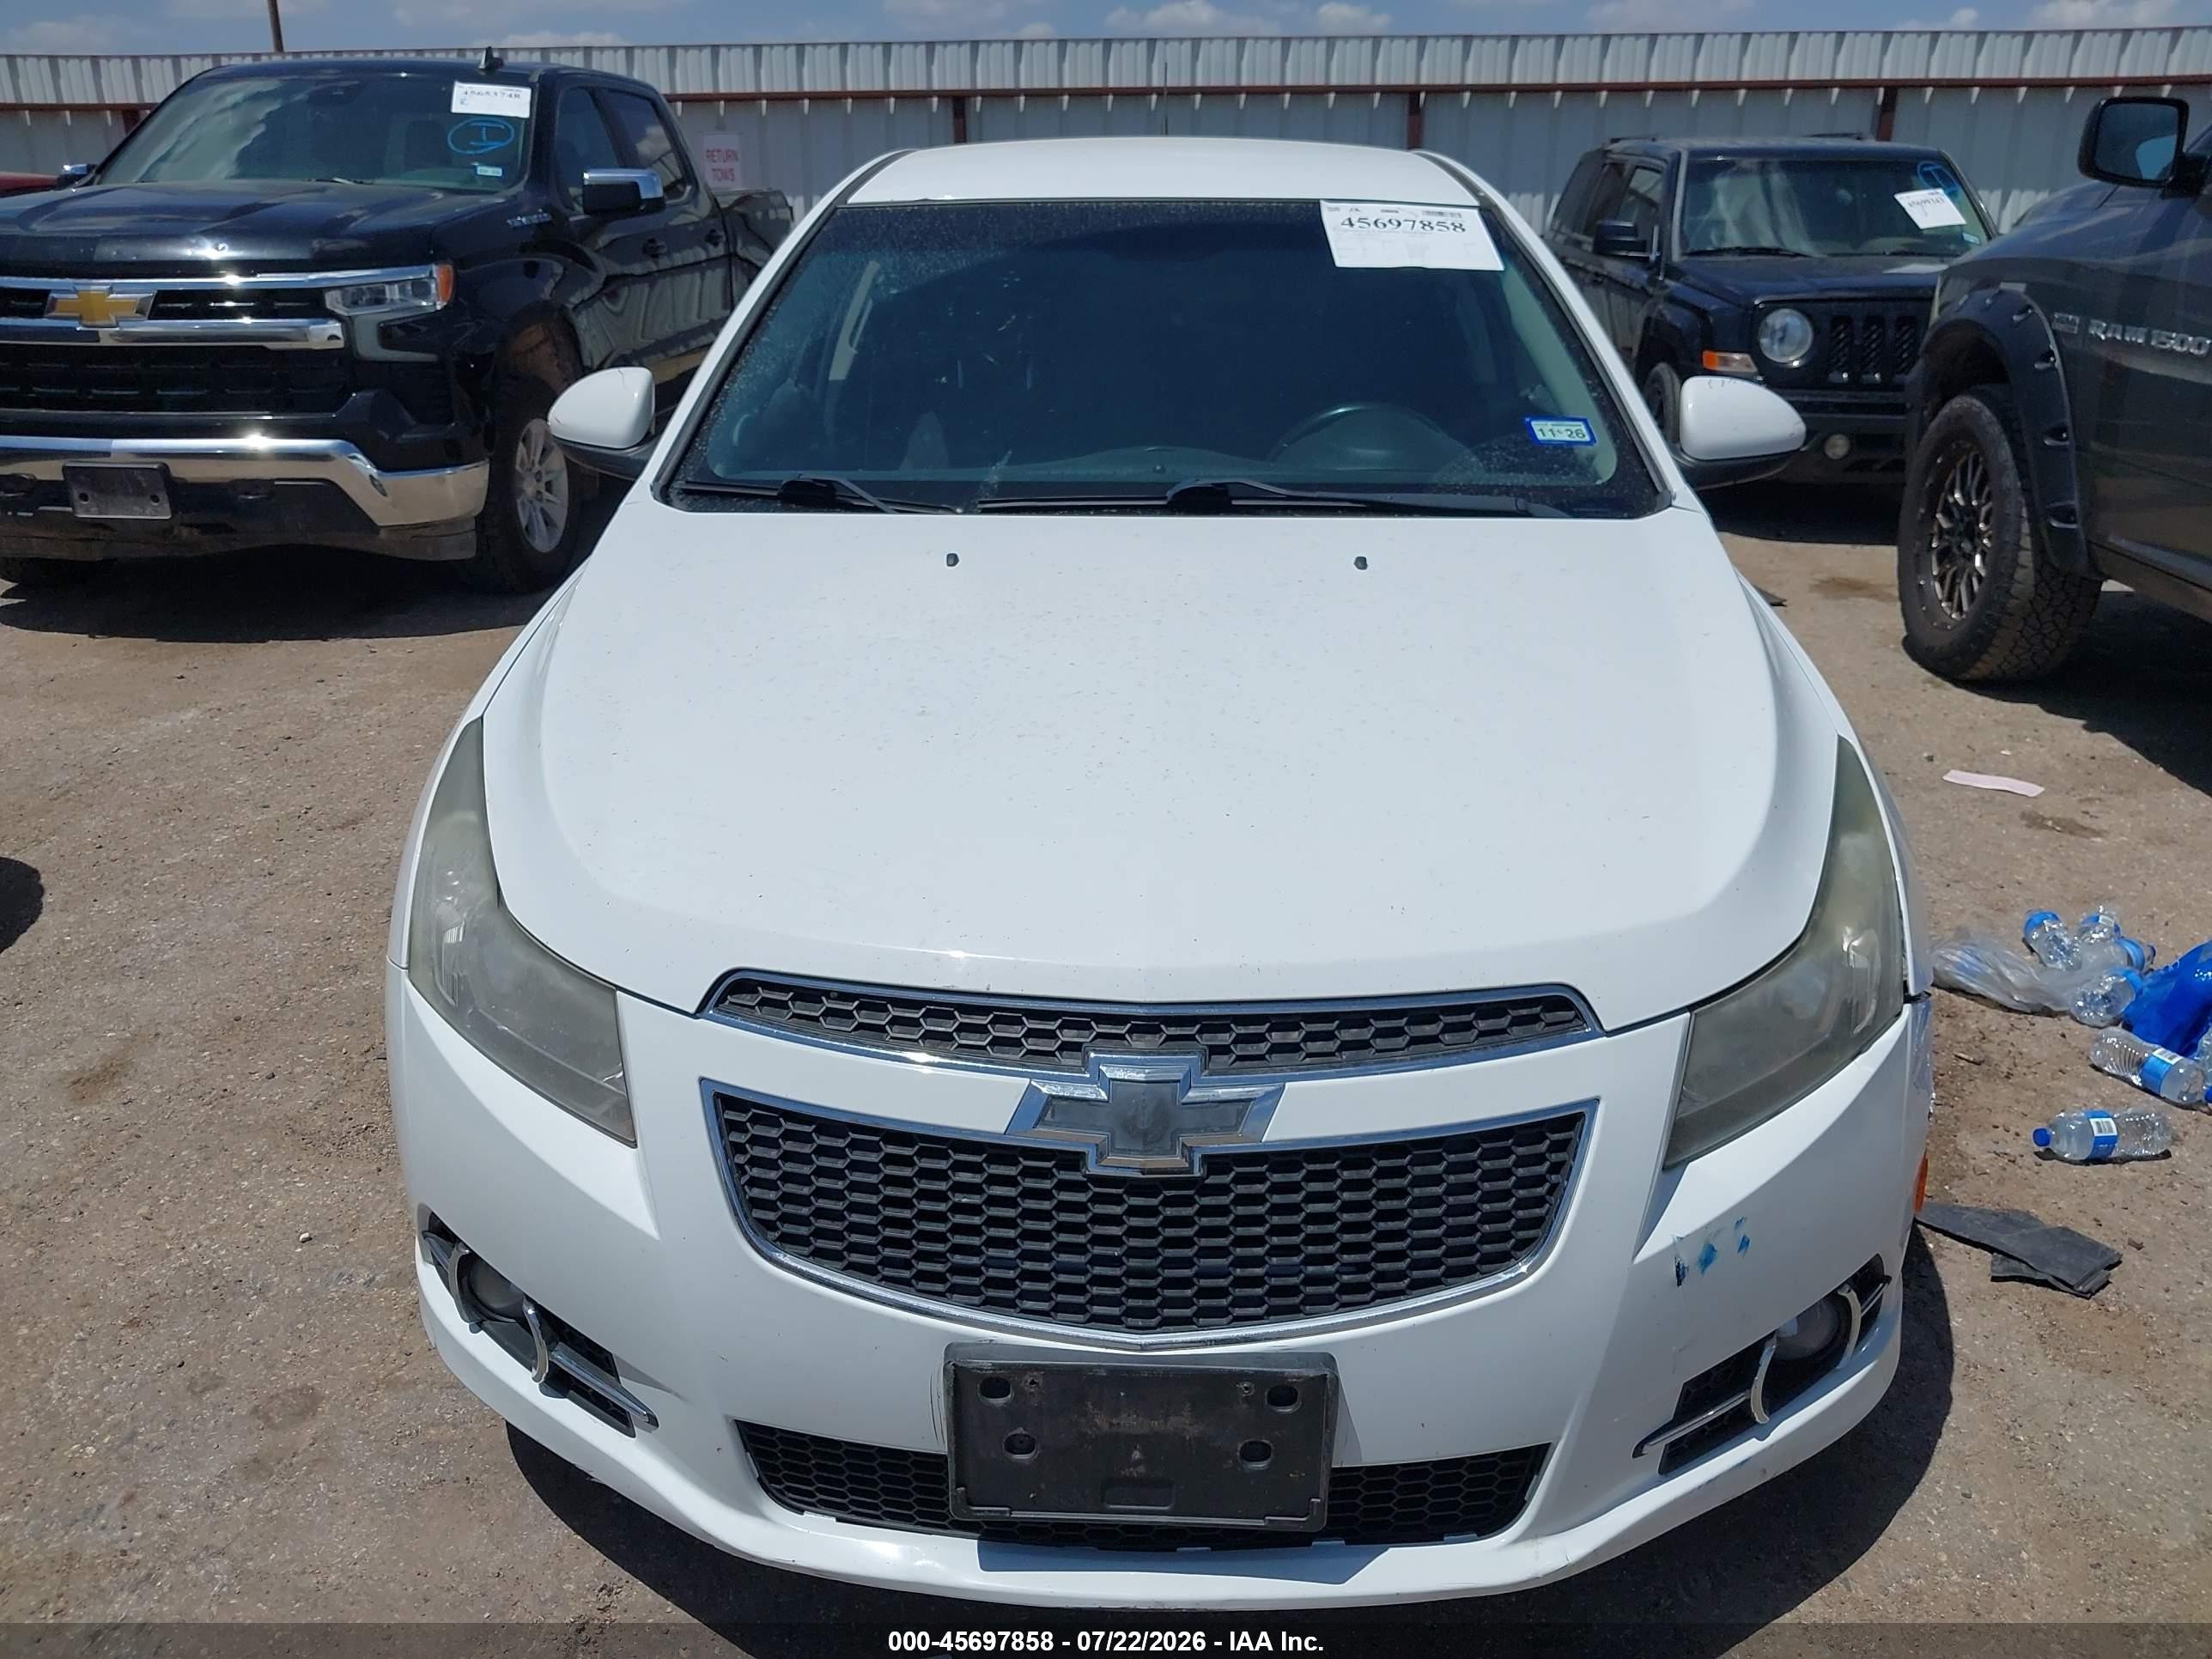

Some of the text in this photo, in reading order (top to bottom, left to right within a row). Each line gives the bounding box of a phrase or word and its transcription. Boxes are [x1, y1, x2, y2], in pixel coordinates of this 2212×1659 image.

[706, 149, 738, 163] RETURN
[711, 167, 736, 182] TOWS
[1340, 216, 1467, 234] 45697858
[2087, 319, 2147, 343] RAM
[2150, 329, 2212, 356] 1500
